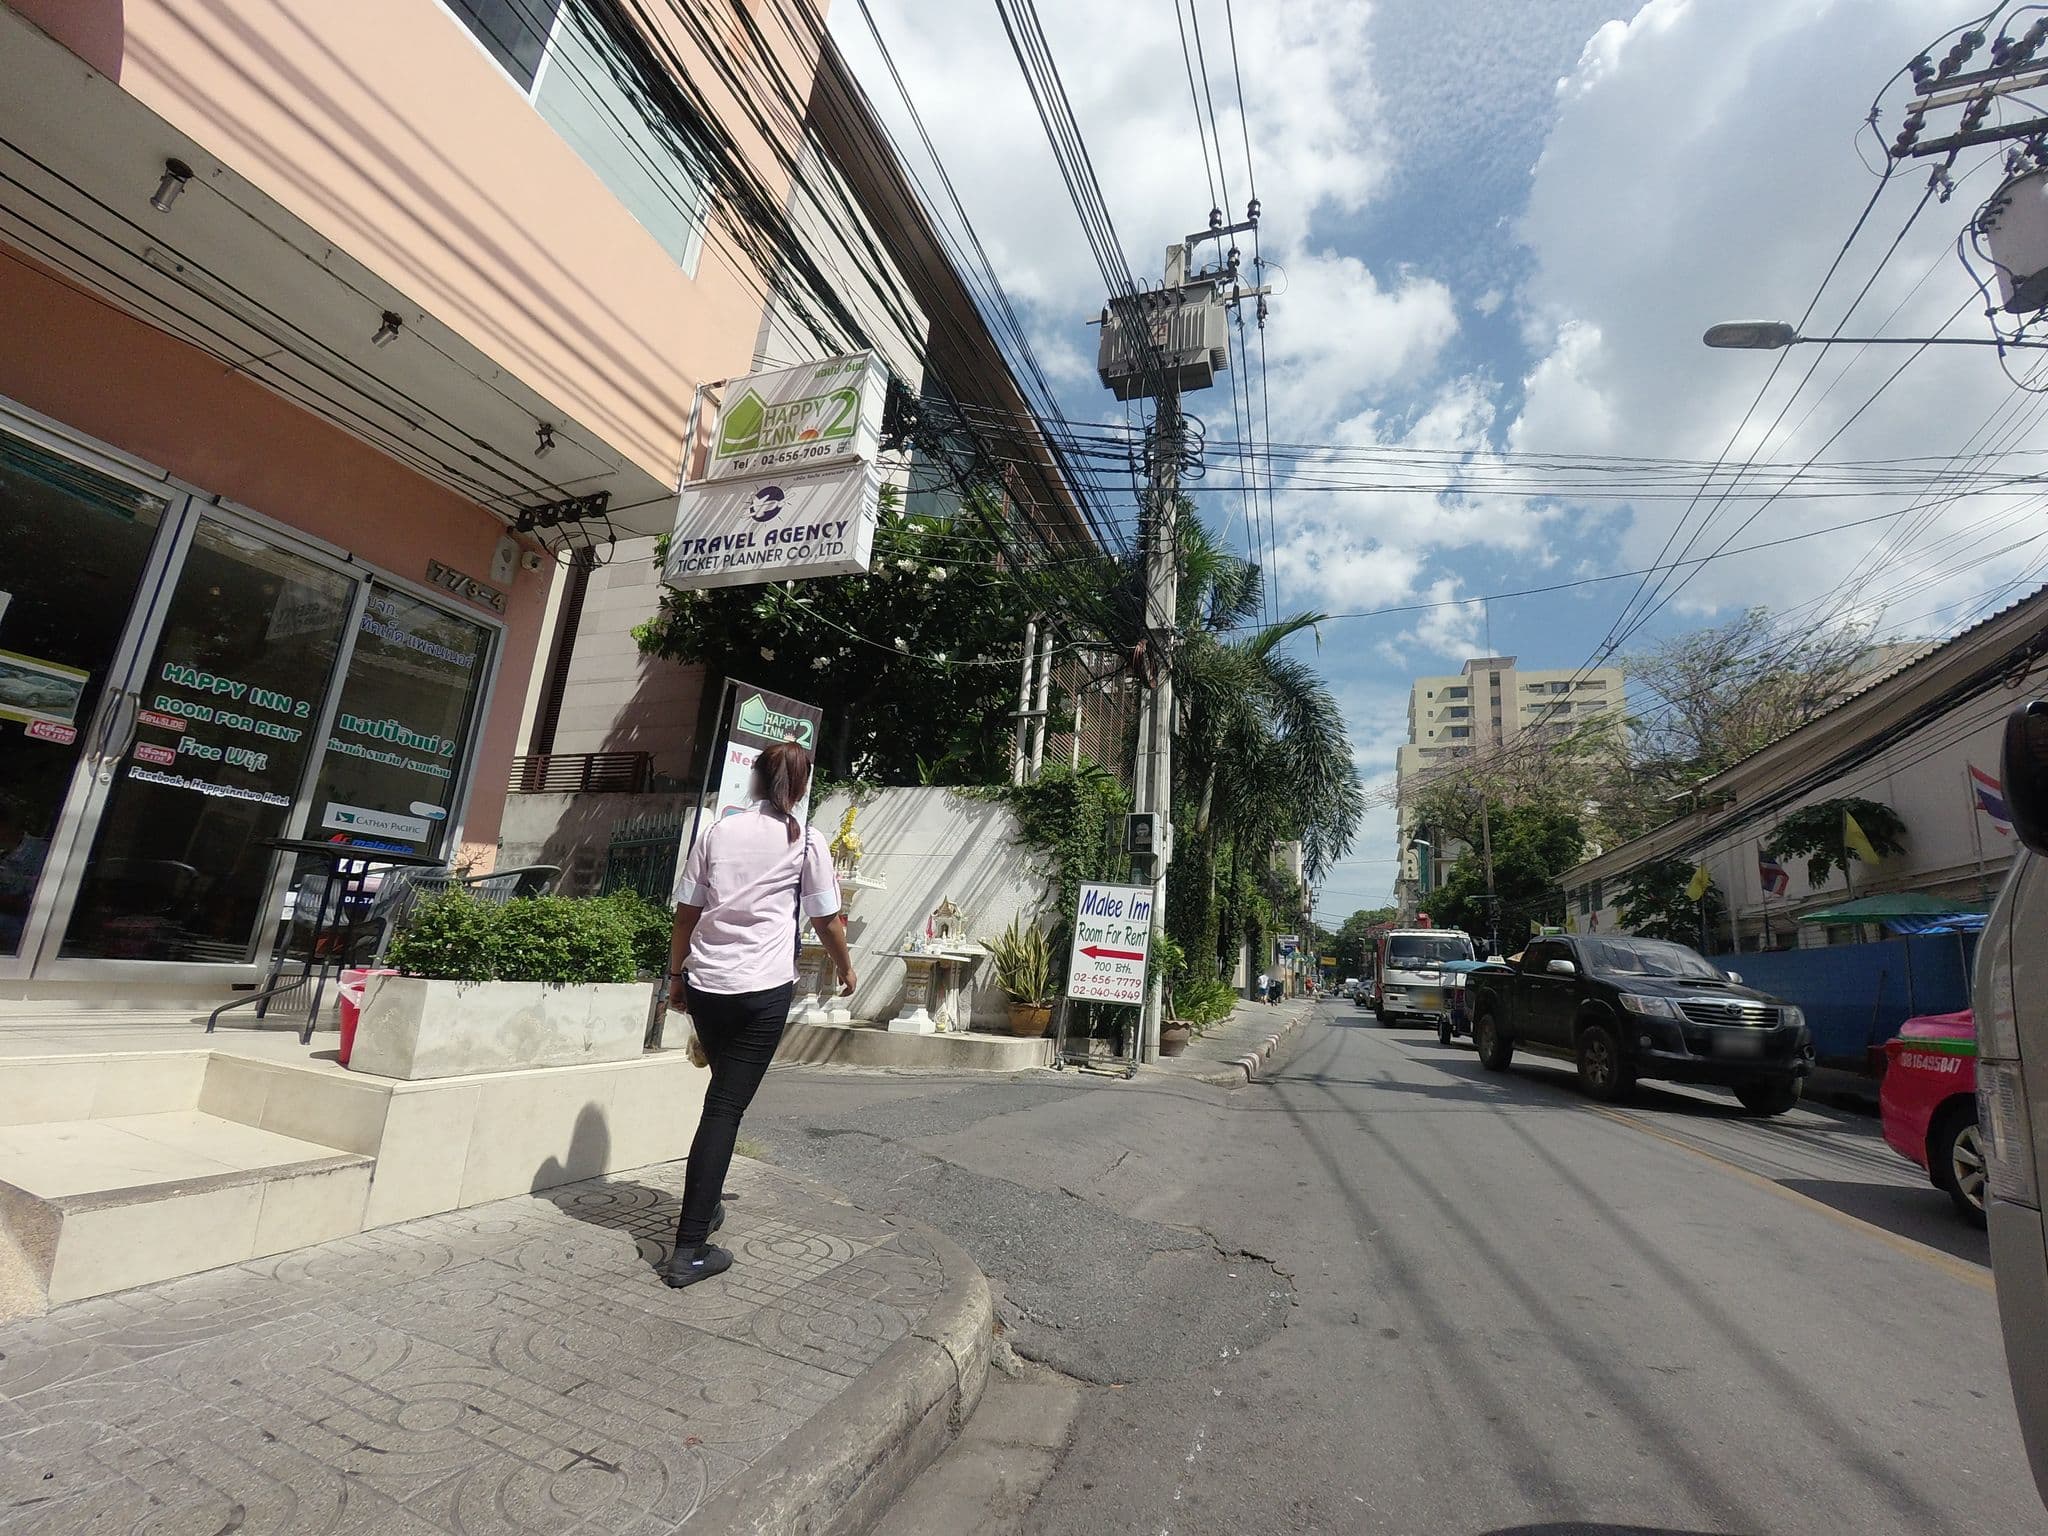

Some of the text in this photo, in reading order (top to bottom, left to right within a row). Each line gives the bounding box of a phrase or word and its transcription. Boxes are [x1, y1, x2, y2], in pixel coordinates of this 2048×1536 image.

[764, 400, 825, 427] HAPPY
[823, 390, 856, 438] 2
[760, 426, 797, 446] INN
[733, 458, 749, 470] Tel
[761, 445, 831, 466] 02-656-7005
[682, 520, 848, 556] TRAVEL AGENCY
[678, 555, 720, 572] TICKET
[722, 548, 783, 568] PLANNER
[433, 563, 504, 609] 77/3-4
[162, 663, 310, 718] HAPPY INN 2
[154, 696, 302, 742] ROOM FOR RENT
[763, 724, 784, 739] INN
[765, 713, 798, 731] HAPPY
[796, 720, 811, 747] 2
[178, 736, 268, 772] Free Wifi
[439, 740, 456, 757] 2
[128, 766, 184, 786] Facebook
[191, 779, 263, 801] Happyinntwo
[262, 793, 289, 806] Hotel
[356, 816, 422, 834] CATHAY PACIFIC
[1080, 889, 1150, 920] Malee Inn
[1077, 922, 1148, 947] Room For Rent
[1094, 962, 1111, 972] 700
[1072, 985, 1140, 1000] 02-040-4949
[1073, 972, 1141, 988] 02-656-7779
